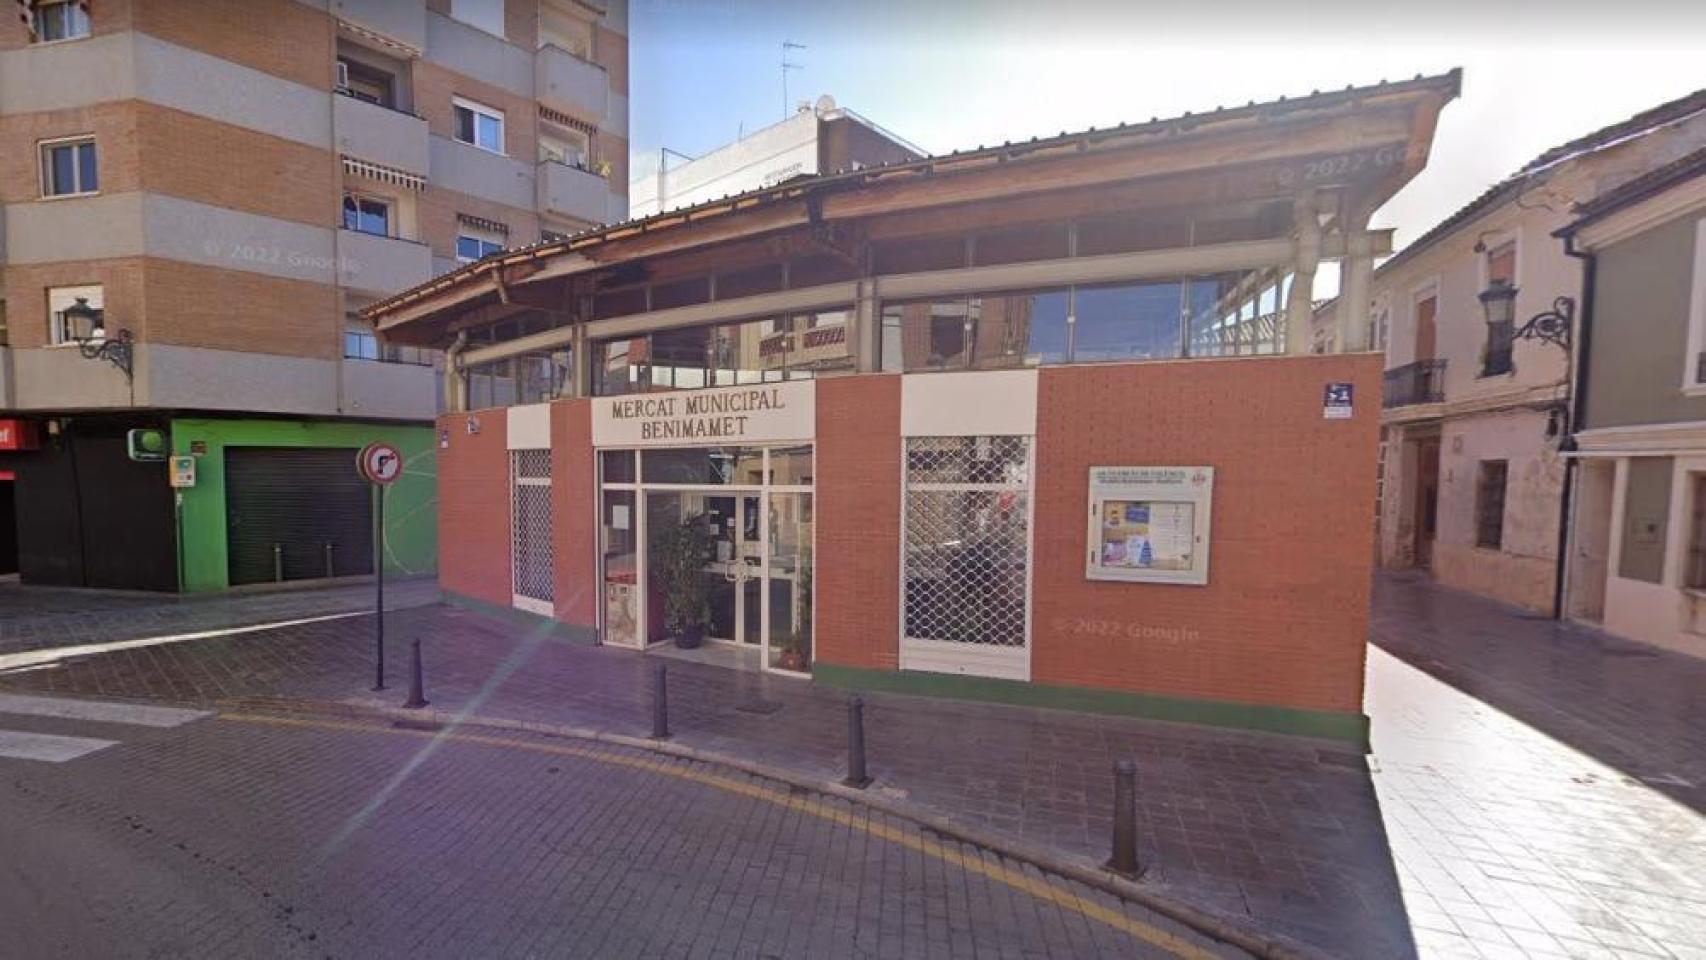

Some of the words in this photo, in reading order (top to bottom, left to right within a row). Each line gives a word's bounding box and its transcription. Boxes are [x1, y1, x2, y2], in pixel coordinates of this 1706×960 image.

[612, 398, 676, 418] MERCAT
[686, 389, 786, 415] MUNICIPAL
[641, 416, 748, 440] BENIMAMET
